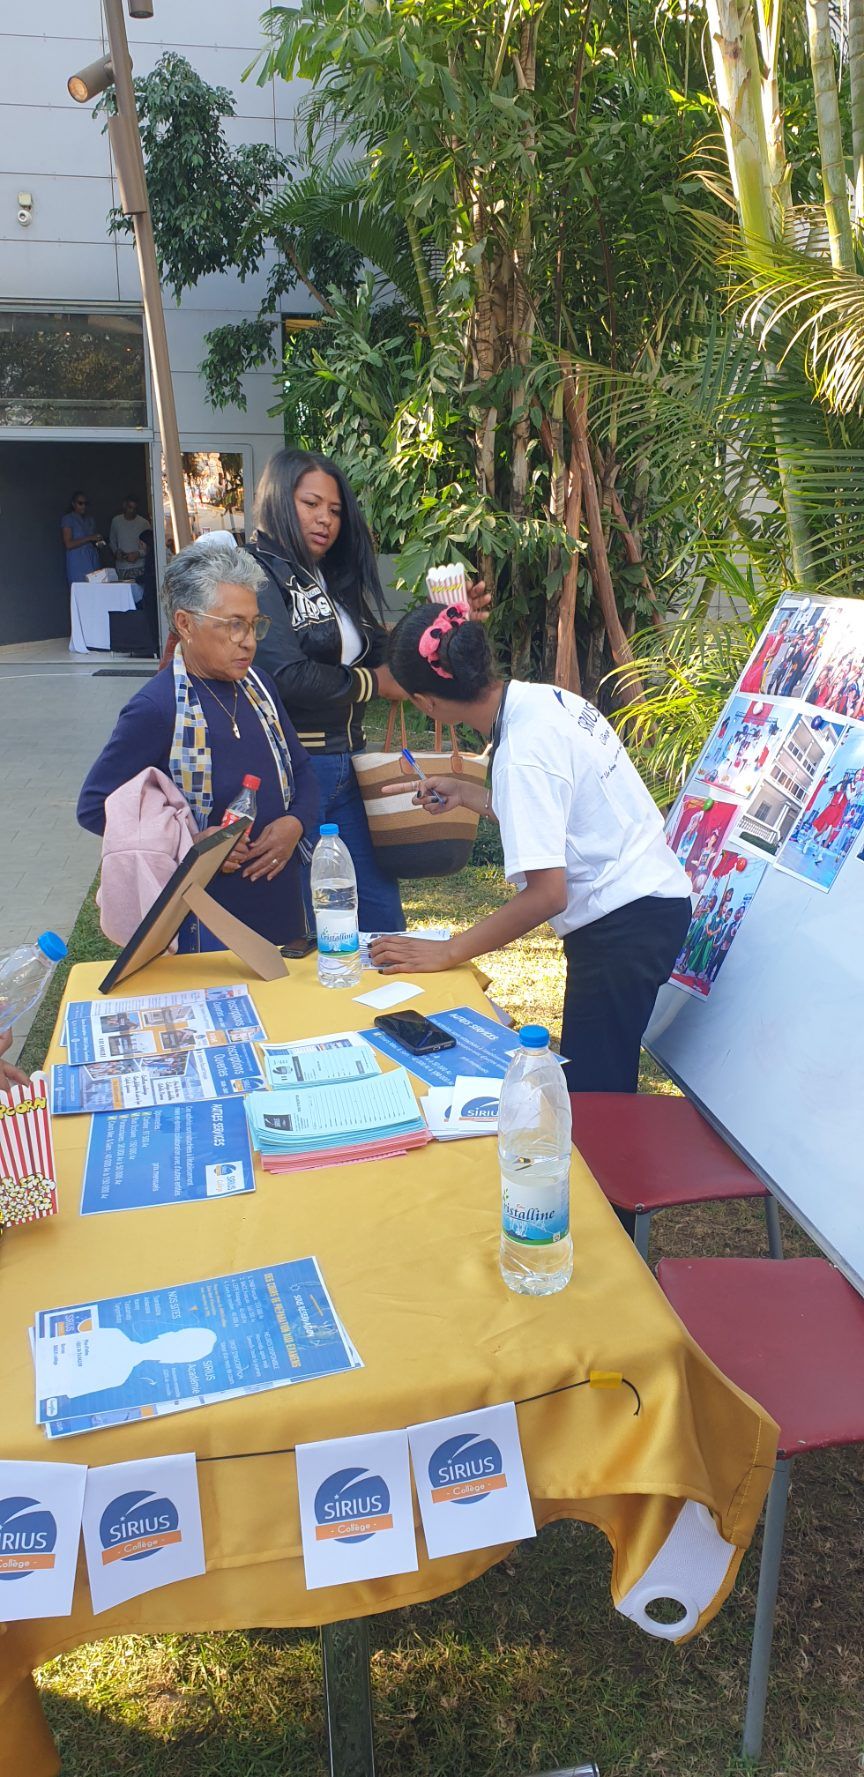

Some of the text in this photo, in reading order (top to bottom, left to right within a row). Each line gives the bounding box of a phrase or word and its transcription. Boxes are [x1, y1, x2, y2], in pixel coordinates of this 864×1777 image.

[214, 1053, 229, 1077] Ouvertes
[229, 1045, 244, 1075] nscriptions
[467, 1108, 498, 1117] SIRIU
[203, 1361, 215, 1381] SIRIUS
[438, 1456, 495, 1483] SIRIUS
[453, 1484, 485, 1495] Collège
[324, 1495, 382, 1520] SIRIUS
[110, 1515, 170, 1542] SIRIUS
[338, 1523, 371, 1534] Collège
[0, 1532, 47, 1550] RIUS
[124, 1540, 158, 1553] Collège
